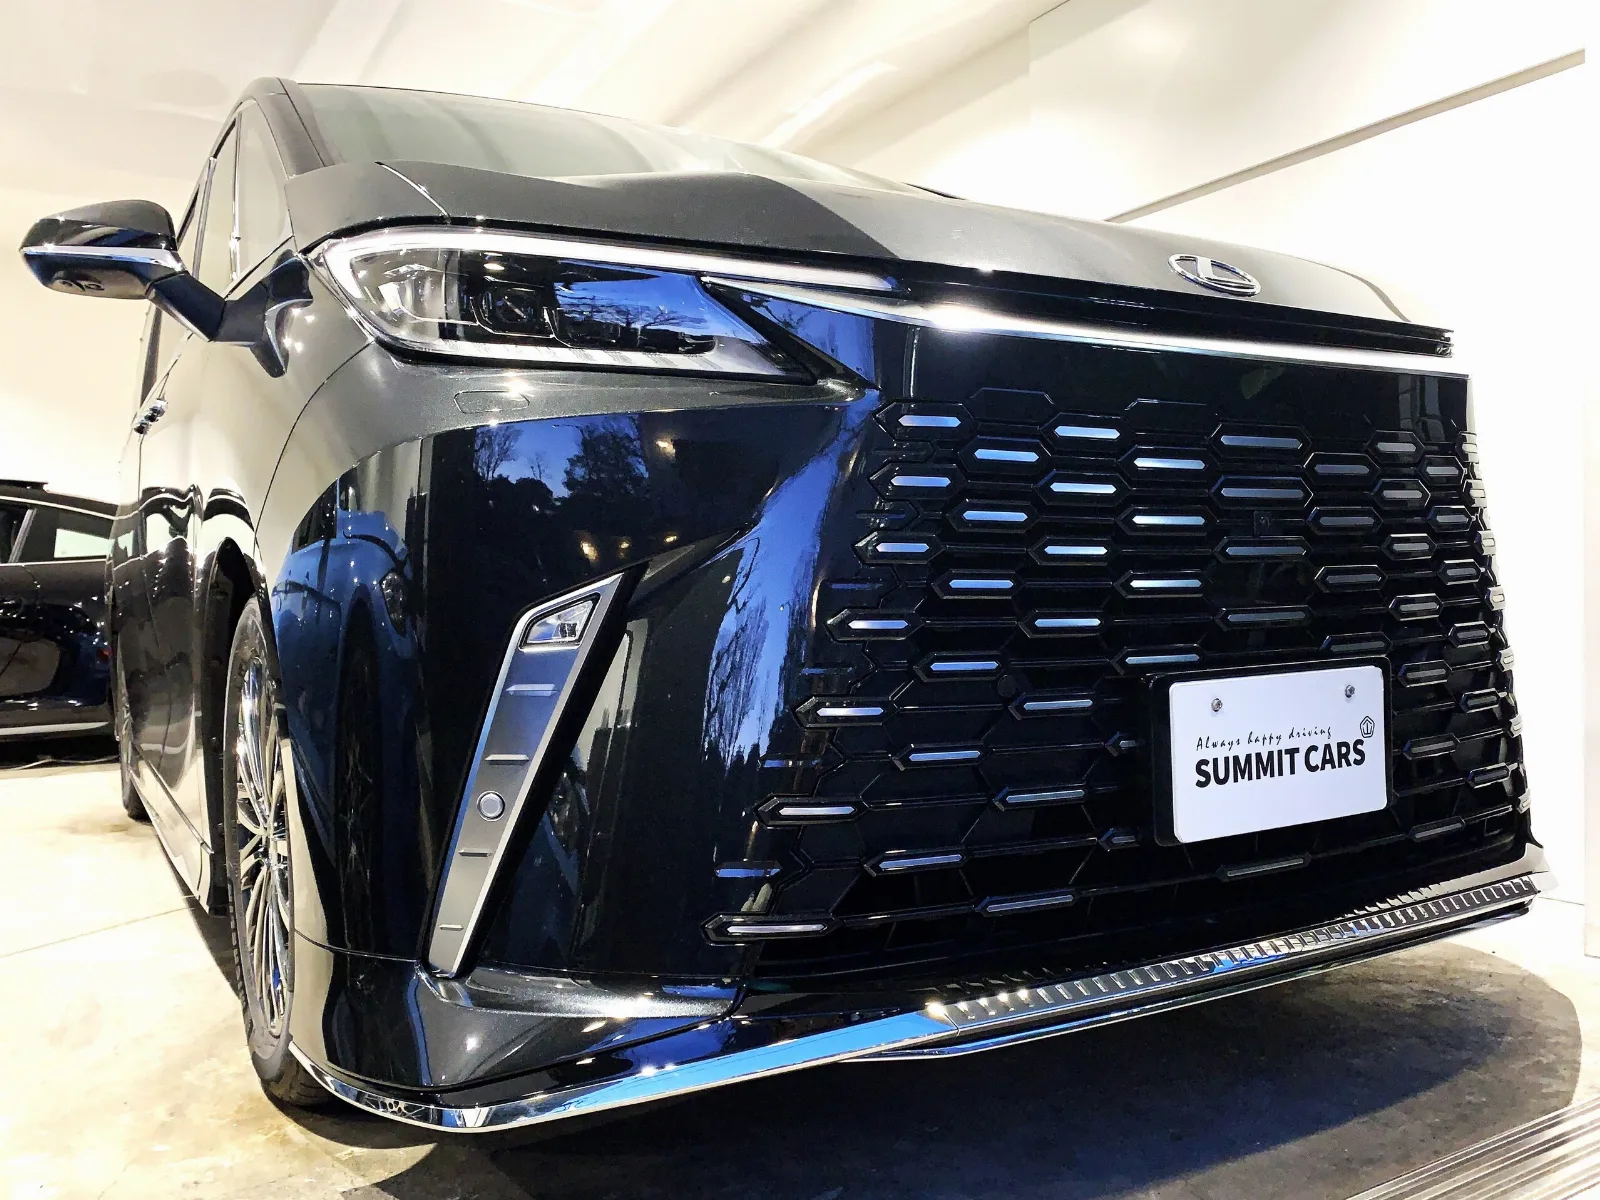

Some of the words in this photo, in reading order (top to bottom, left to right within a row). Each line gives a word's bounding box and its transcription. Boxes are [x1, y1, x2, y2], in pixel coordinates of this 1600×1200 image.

[1196, 736, 1241, 752] Always
[1247, 731, 1282, 746] happy
[1288, 726, 1332, 740] driving
[1195, 747, 1300, 788] SUMMIT
[1304, 738, 1366, 773] CARS
